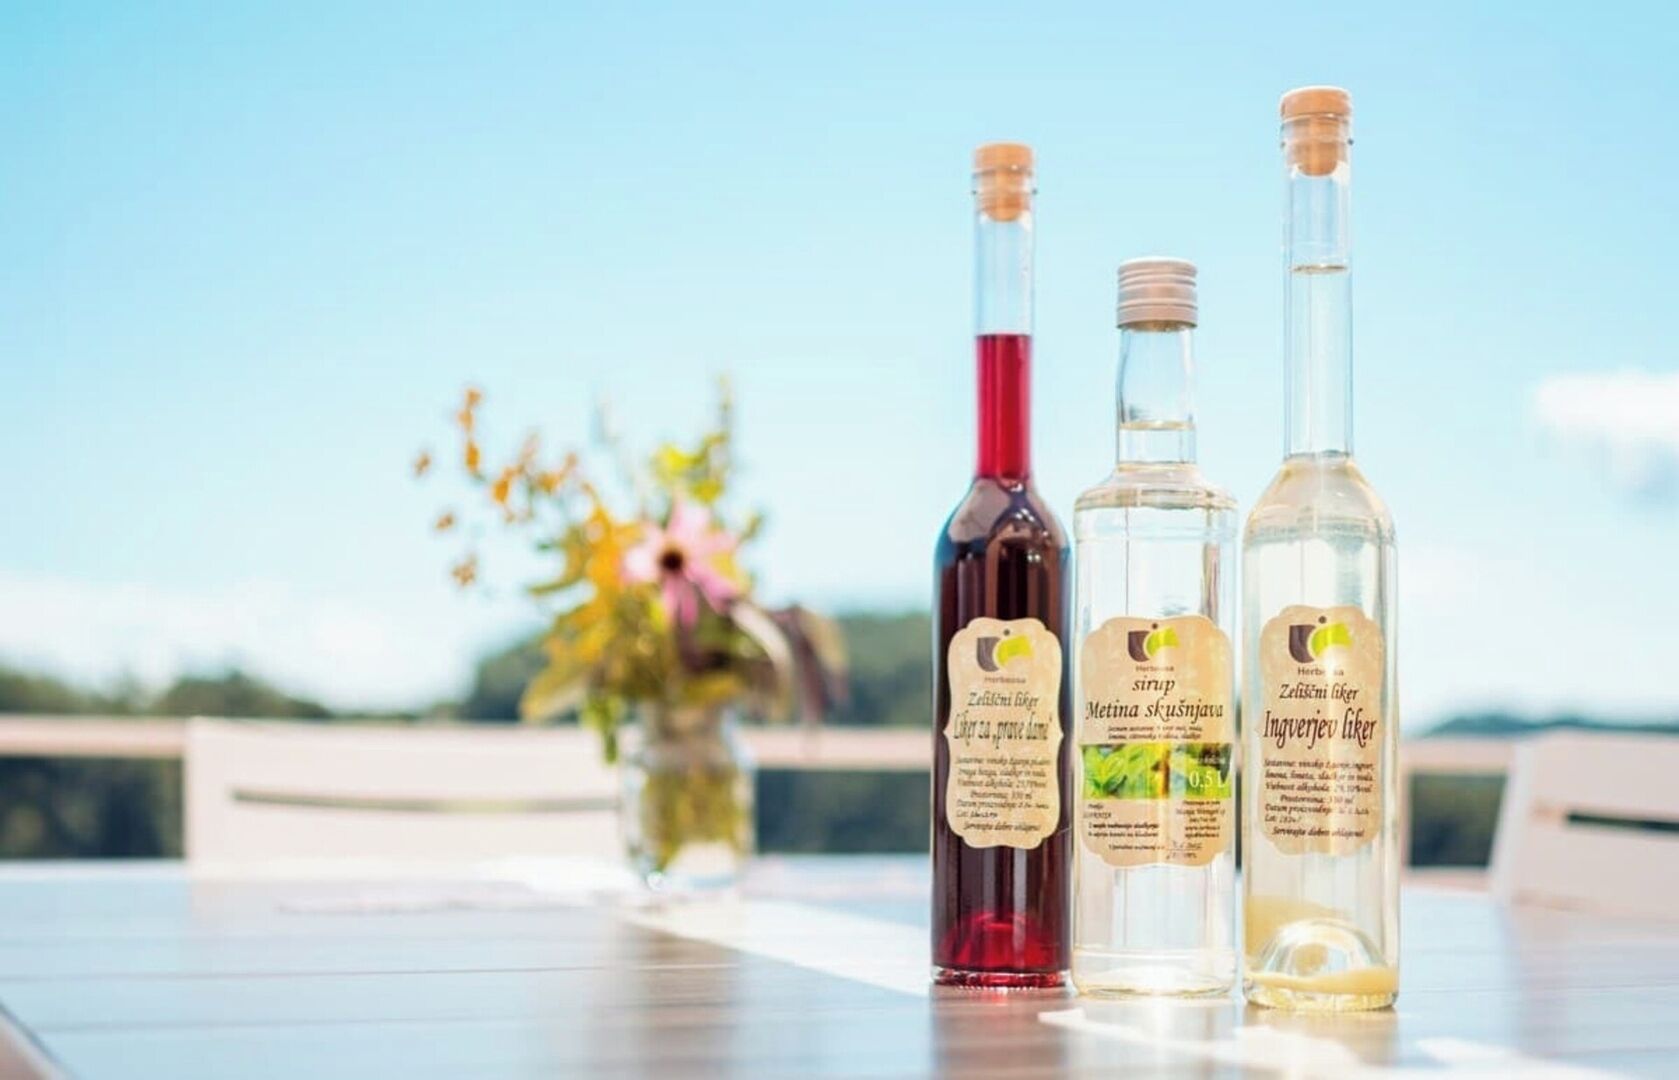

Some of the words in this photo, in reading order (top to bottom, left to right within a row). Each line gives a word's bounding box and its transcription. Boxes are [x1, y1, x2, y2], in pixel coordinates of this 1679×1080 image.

[1132, 675, 1175, 696] sirup
[1279, 682, 1328, 699] Zeliščni
[1331, 682, 1359, 704] liker
[1014, 691, 1040, 711] liker
[1085, 699, 1139, 720] Metina
[1144, 697, 1224, 724] skušnjava
[978, 720, 991, 739] za
[1263, 709, 1338, 750] Ingverjev
[1342, 707, 1377, 748] liker
